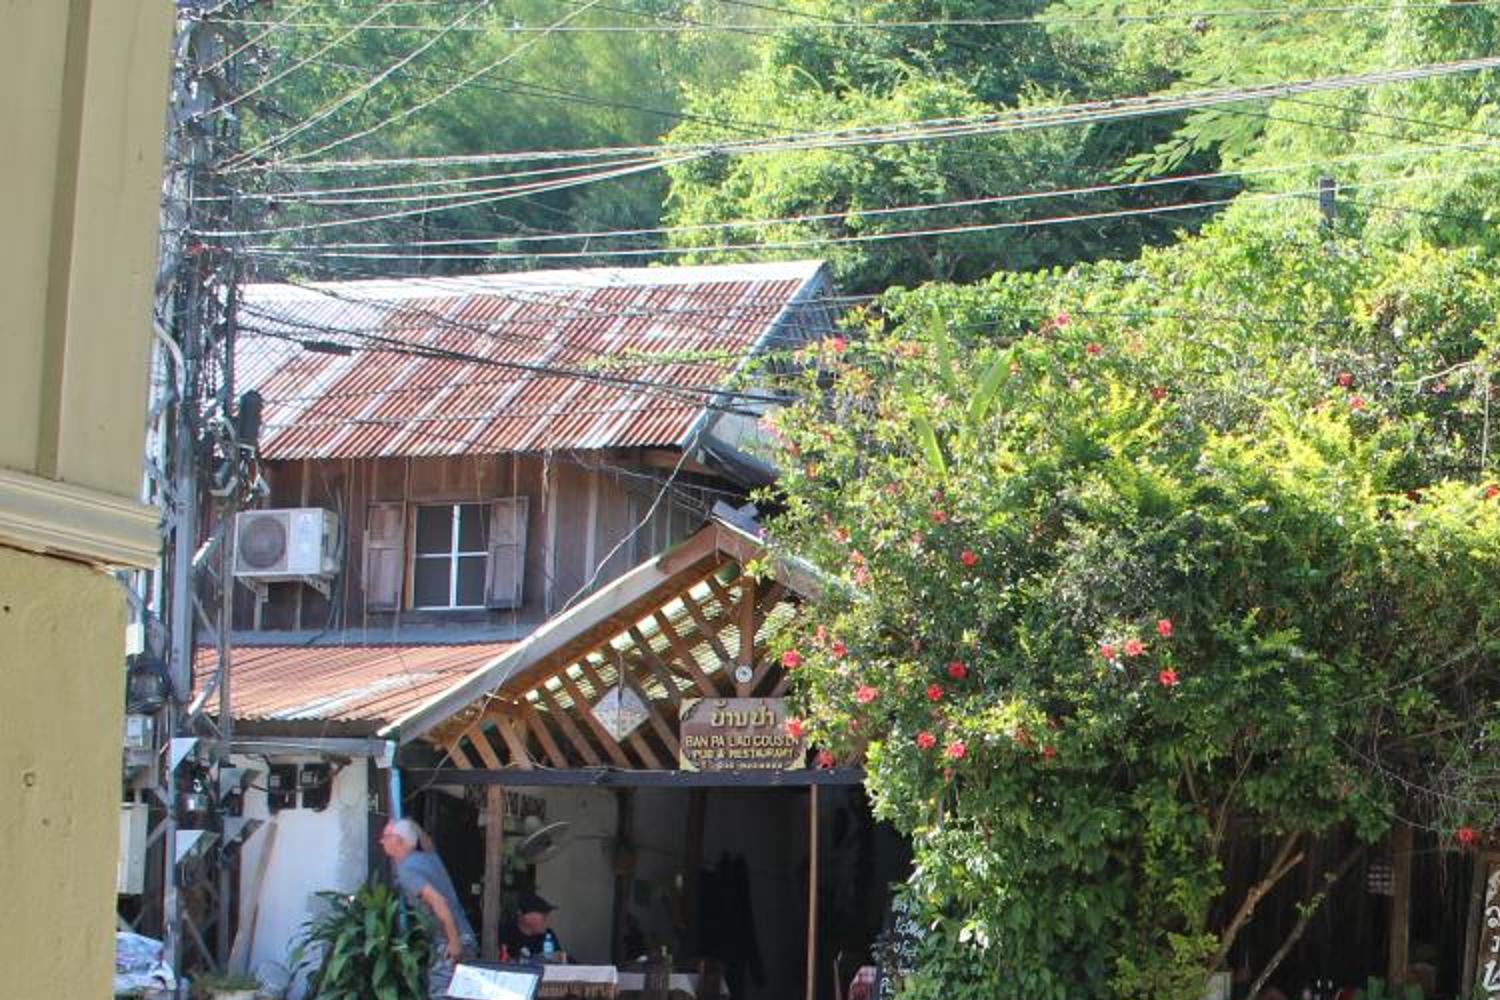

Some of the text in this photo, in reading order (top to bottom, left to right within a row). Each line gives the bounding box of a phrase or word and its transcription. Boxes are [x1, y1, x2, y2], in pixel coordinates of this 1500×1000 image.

[685, 736, 708, 748] BAN
[711, 736, 726, 747] PA
[729, 736, 751, 748] LAO
